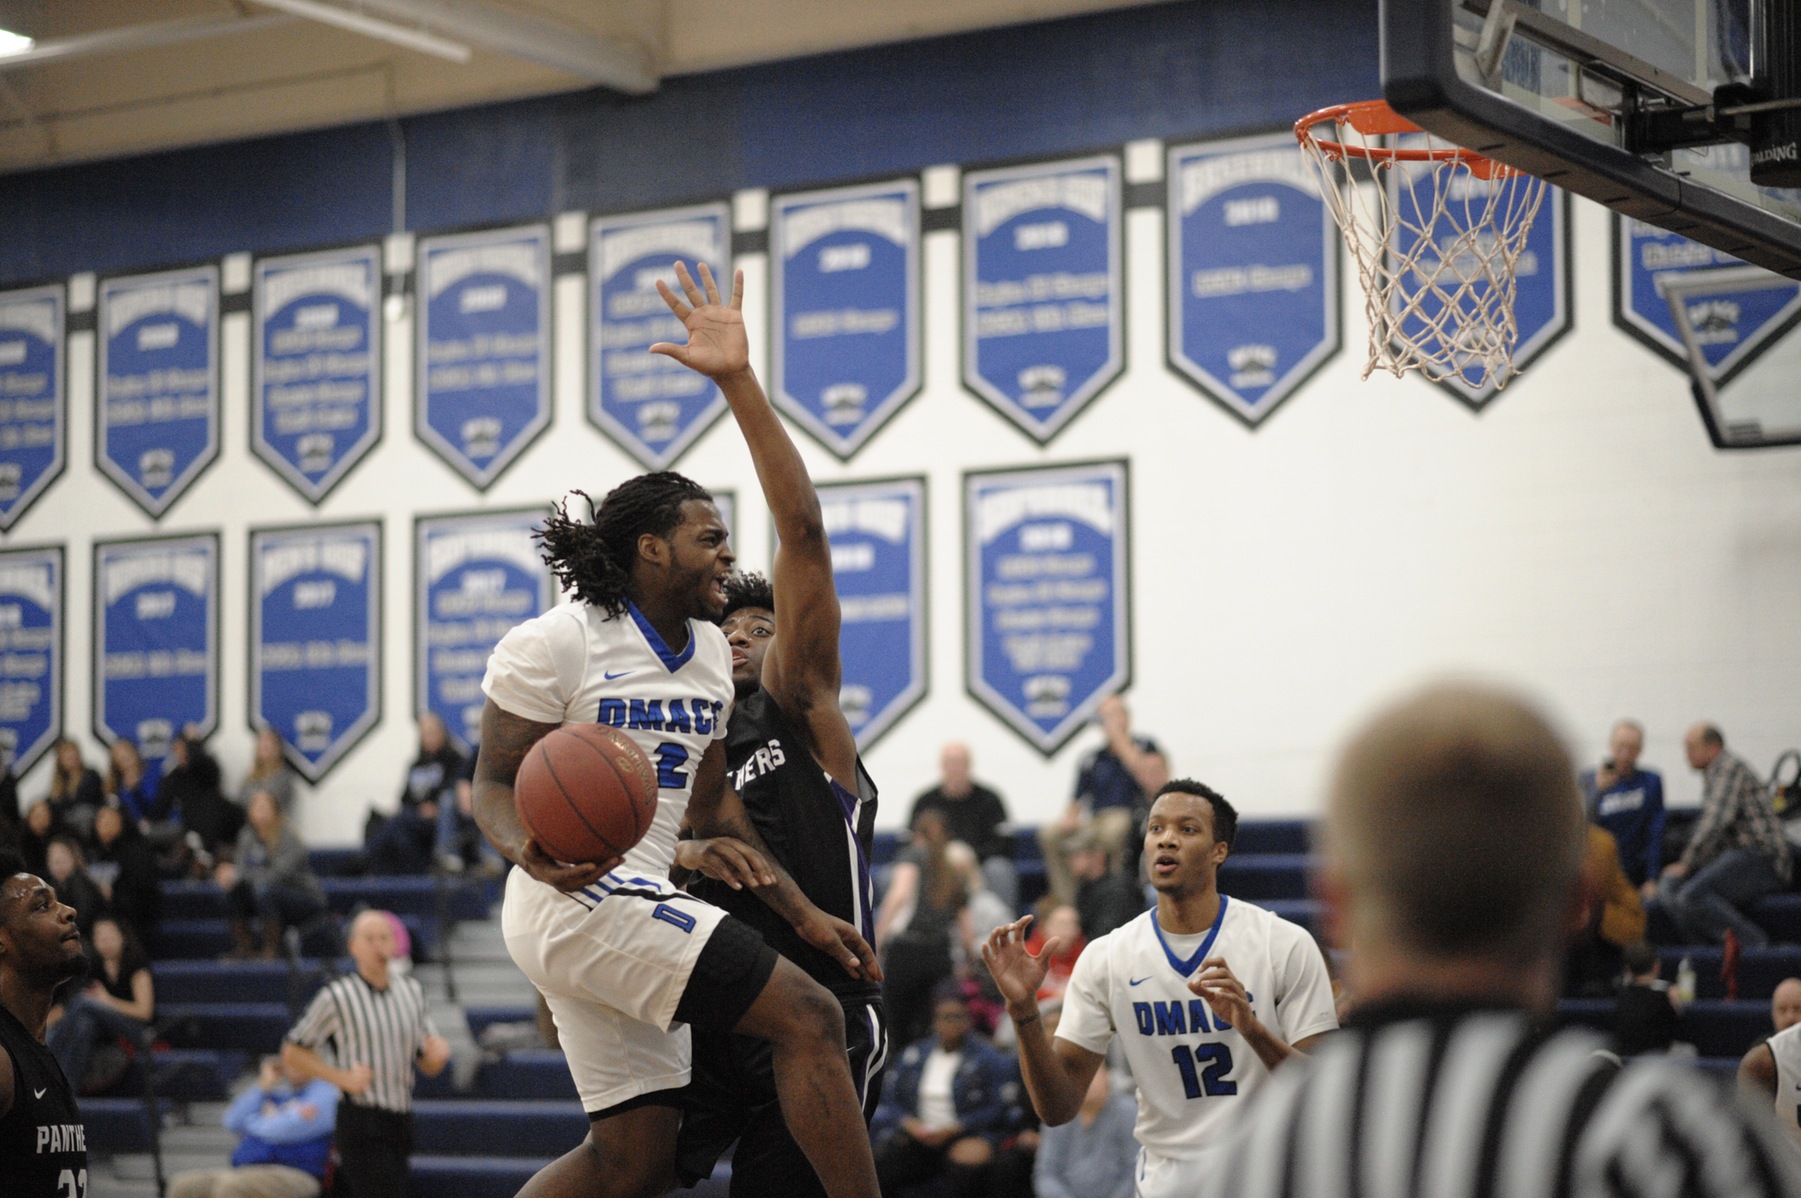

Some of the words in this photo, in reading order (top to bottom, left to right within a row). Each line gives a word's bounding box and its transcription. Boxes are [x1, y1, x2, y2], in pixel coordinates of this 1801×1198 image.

[651, 903, 697, 934] D
[1132, 991, 1256, 1036] DMAC
[1171, 1042, 1238, 1099] 12
